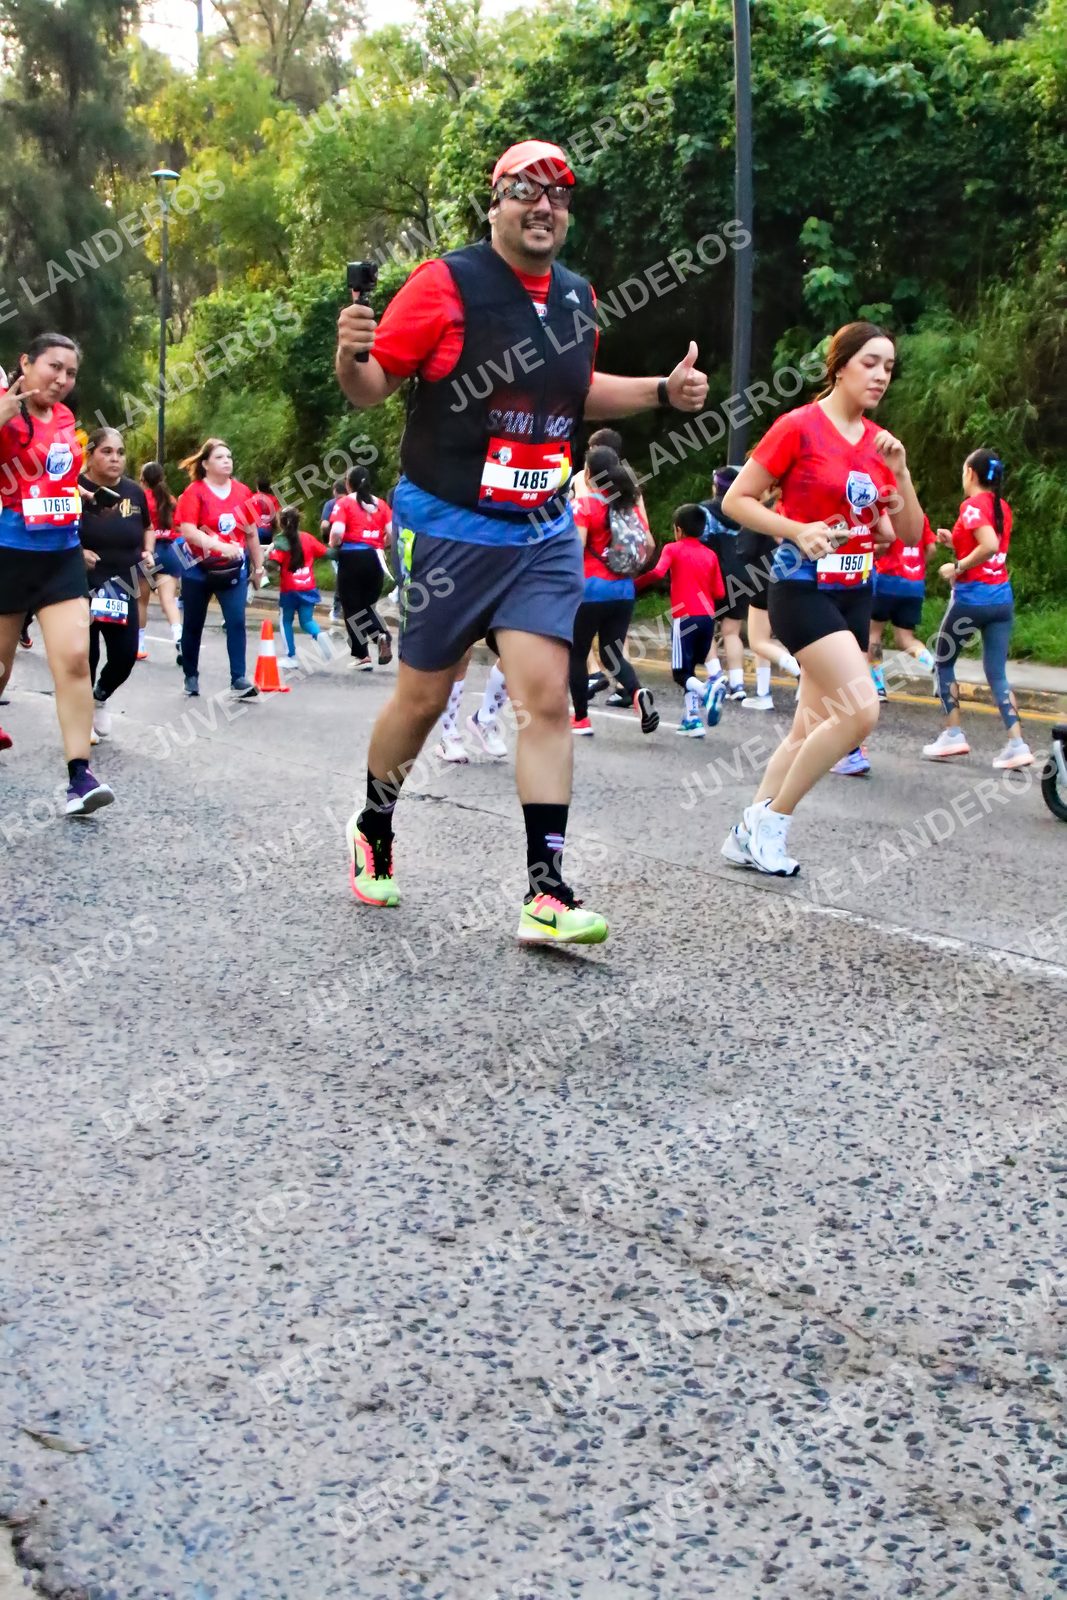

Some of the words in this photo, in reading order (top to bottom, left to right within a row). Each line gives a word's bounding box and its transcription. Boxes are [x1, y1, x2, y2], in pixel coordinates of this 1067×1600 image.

[513, 470, 549, 489] 1485
[43, 498, 71, 513] 17615
[840, 555, 863, 571] 1950
